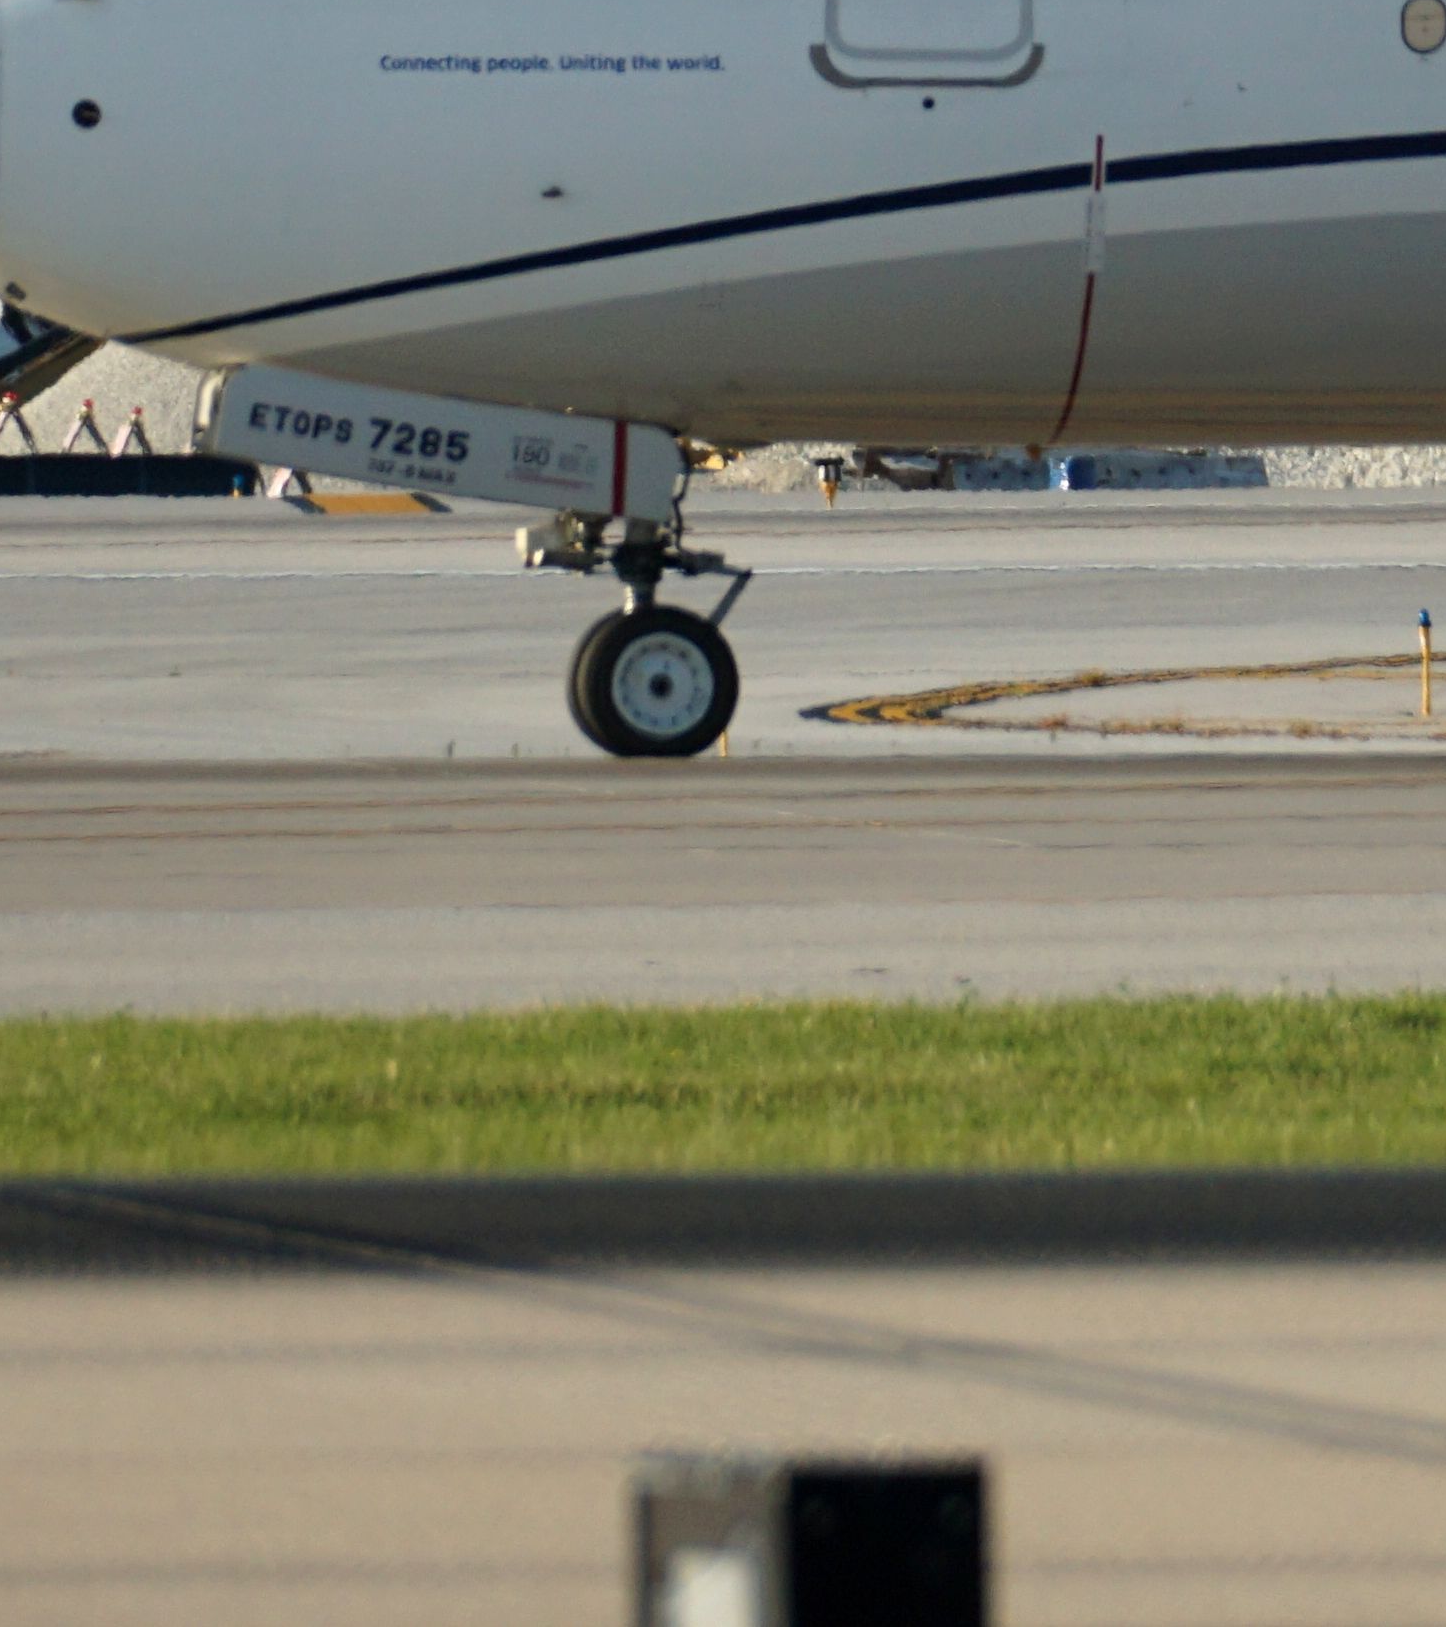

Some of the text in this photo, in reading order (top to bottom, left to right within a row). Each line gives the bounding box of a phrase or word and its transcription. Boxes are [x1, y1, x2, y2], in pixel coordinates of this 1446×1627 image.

[379, 54, 725, 73] Connecting people. Uniting the world.
[249, 402, 470, 462] ETOPS 7285
